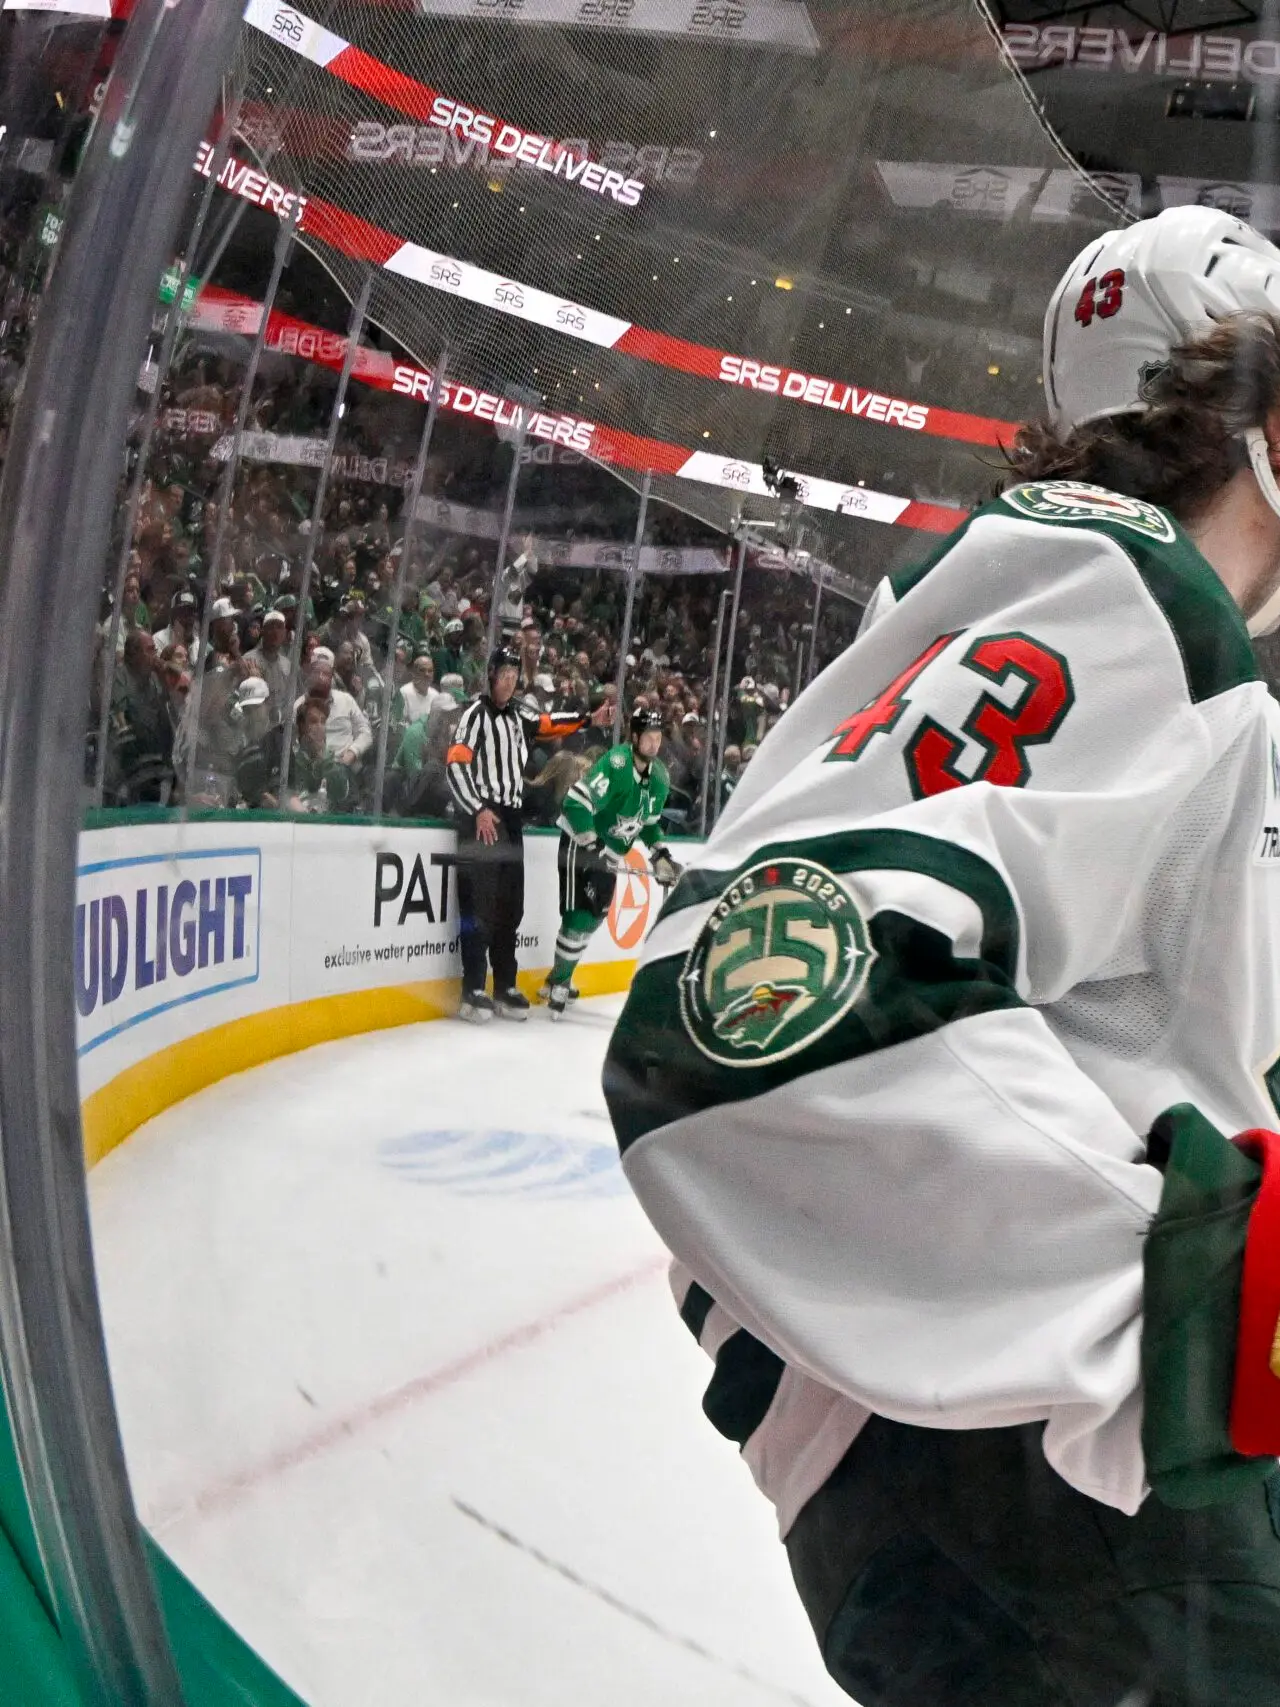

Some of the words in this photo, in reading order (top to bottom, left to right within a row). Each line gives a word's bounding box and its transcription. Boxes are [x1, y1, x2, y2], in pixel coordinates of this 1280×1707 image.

[271, 14, 306, 42] SRS
[430, 97, 495, 144] SRS
[495, 125, 645, 206] DELIVERS
[193, 141, 307, 222] ELIVERS
[430, 264, 462, 288] SRS
[494, 287, 525, 309] SRS
[1074, 268, 1126, 327] 43
[556, 309, 586, 331] SRS
[393, 366, 451, 408] SRS
[452, 387, 595, 451] DELIVERS
[719, 356, 781, 393] SRS
[781, 372, 930, 430] DELIVERS
[722, 466, 751, 486] SRS
[840, 493, 869, 511] SRS
[822, 627, 1076, 802] 43
[792, 868, 847, 912] 2025
[75, 894, 129, 1018] UD
[134, 874, 253, 991] LIGHT
[324, 944, 372, 970] exclusive
[373, 942, 405, 962] water
[407, 938, 447, 963] partner
